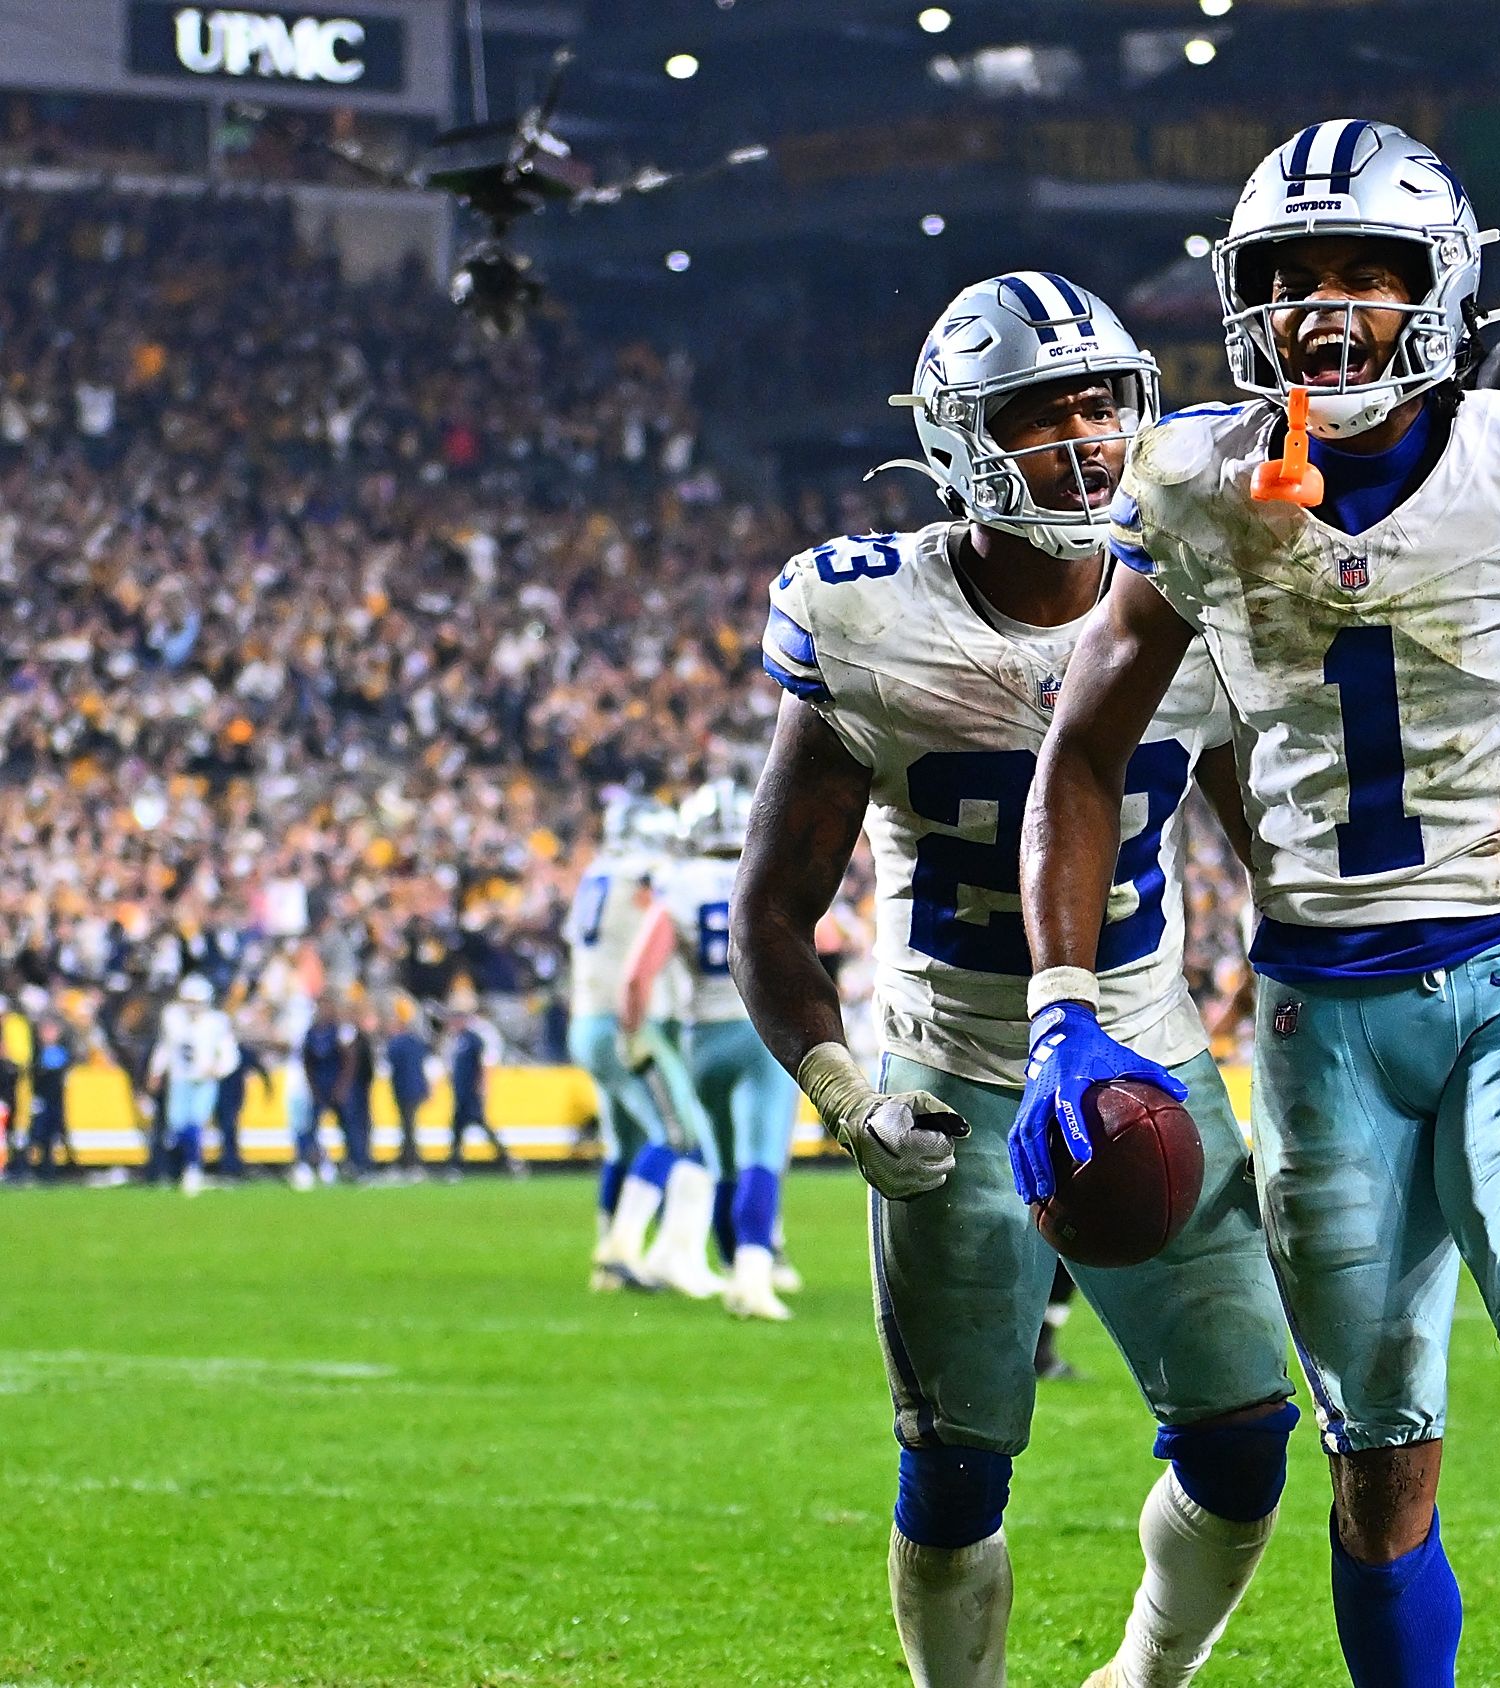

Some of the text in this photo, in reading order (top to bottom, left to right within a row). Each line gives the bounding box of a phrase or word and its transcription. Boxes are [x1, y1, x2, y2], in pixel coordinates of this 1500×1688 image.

[174, 7, 365, 83] UPMC
[1286, 200, 1342, 214] COWBOYS
[1342, 570, 1367, 587] NFL
[1322, 625, 1425, 878] 1
[1061, 1099, 1082, 1141] ADIZERO
